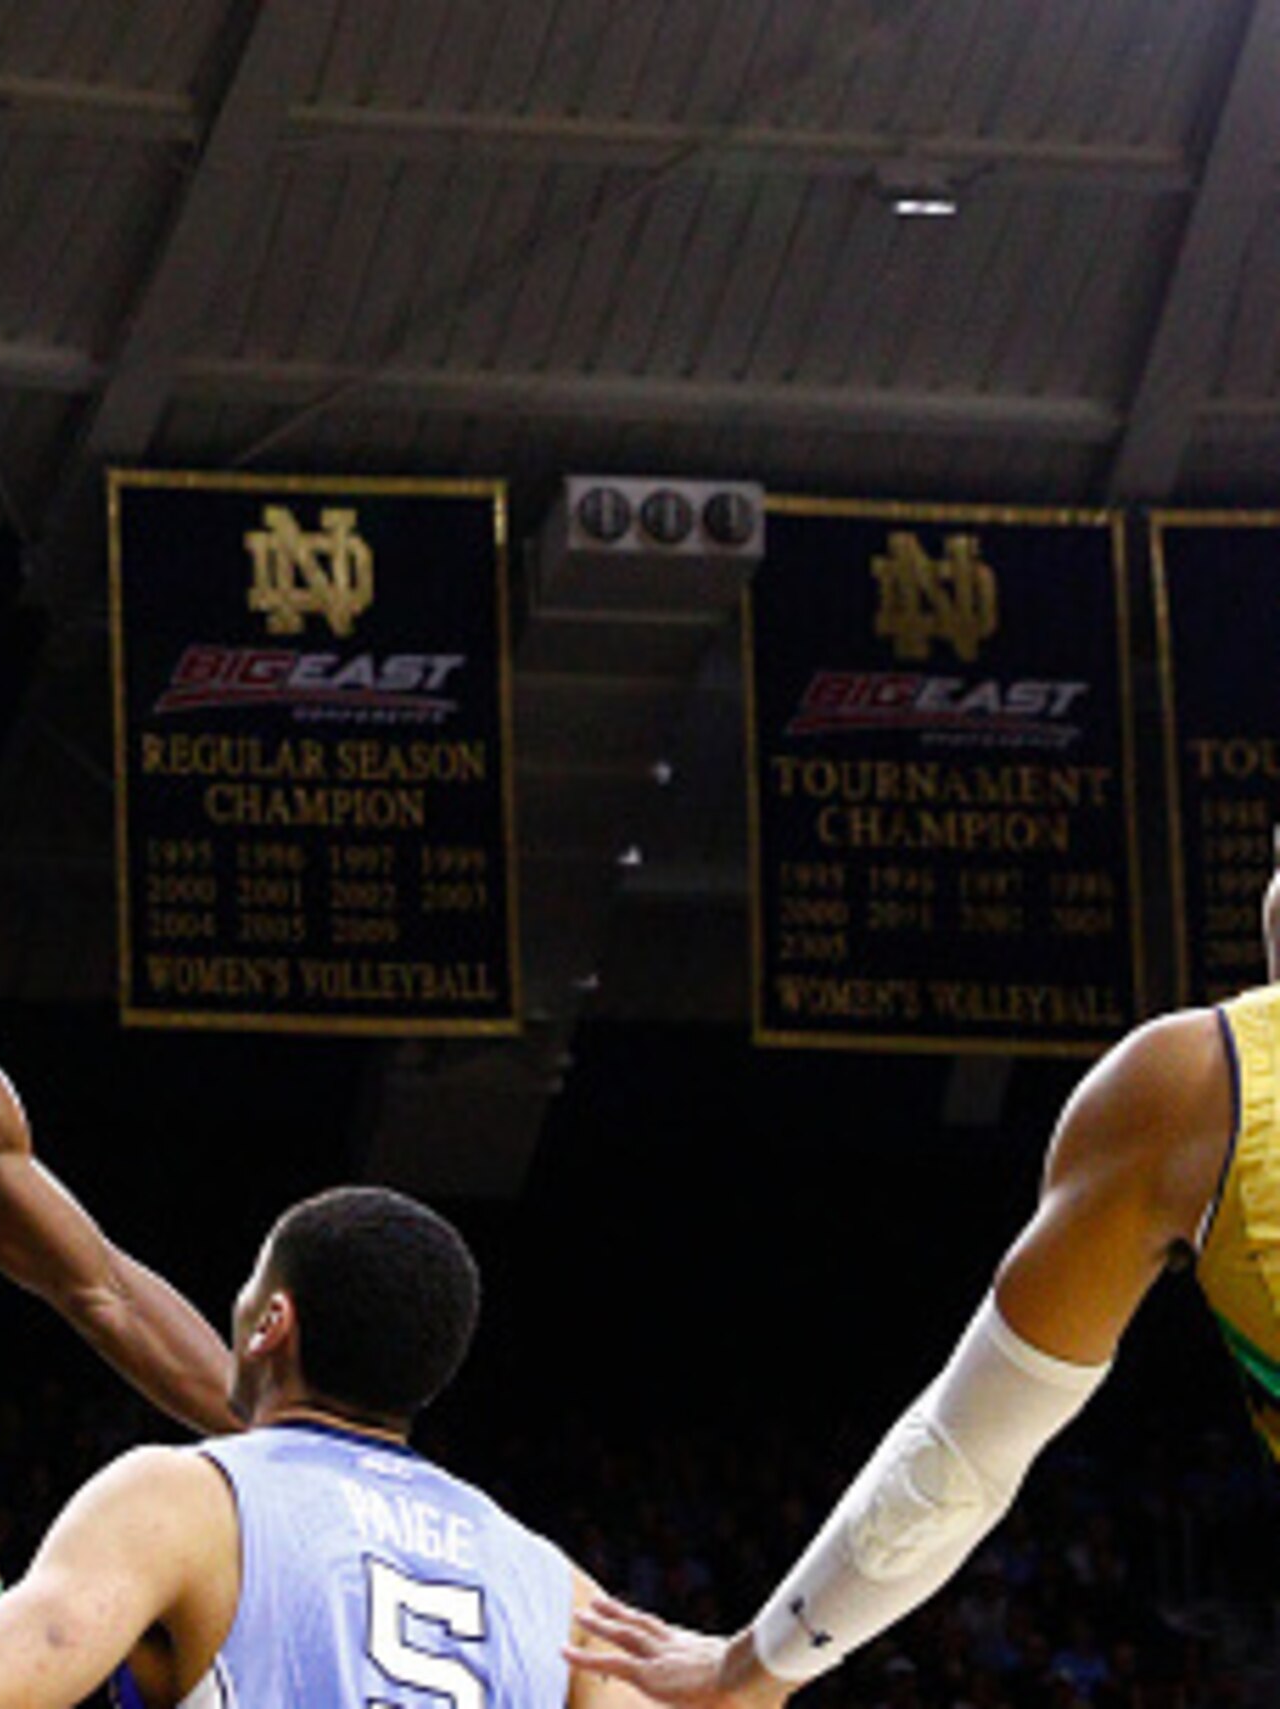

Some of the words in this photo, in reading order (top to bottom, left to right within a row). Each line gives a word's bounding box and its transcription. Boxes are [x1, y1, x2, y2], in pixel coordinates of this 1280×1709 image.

[141, 733, 326, 779] REGULAR
[336, 739, 486, 781] SEASON
[771, 756, 1112, 805] TOURNAMENT
[203, 783, 425, 827] CHAMPION
[817, 806, 1068, 852] CHAMPION
[146, 955, 289, 999] WOMEN'S
[299, 959, 495, 1000] VOLLEYBALL
[928, 981, 1123, 1026] VOLLEYBALL
[340, 1478, 476, 1570] PAIGE
[360, 1551, 494, 1709] 5
